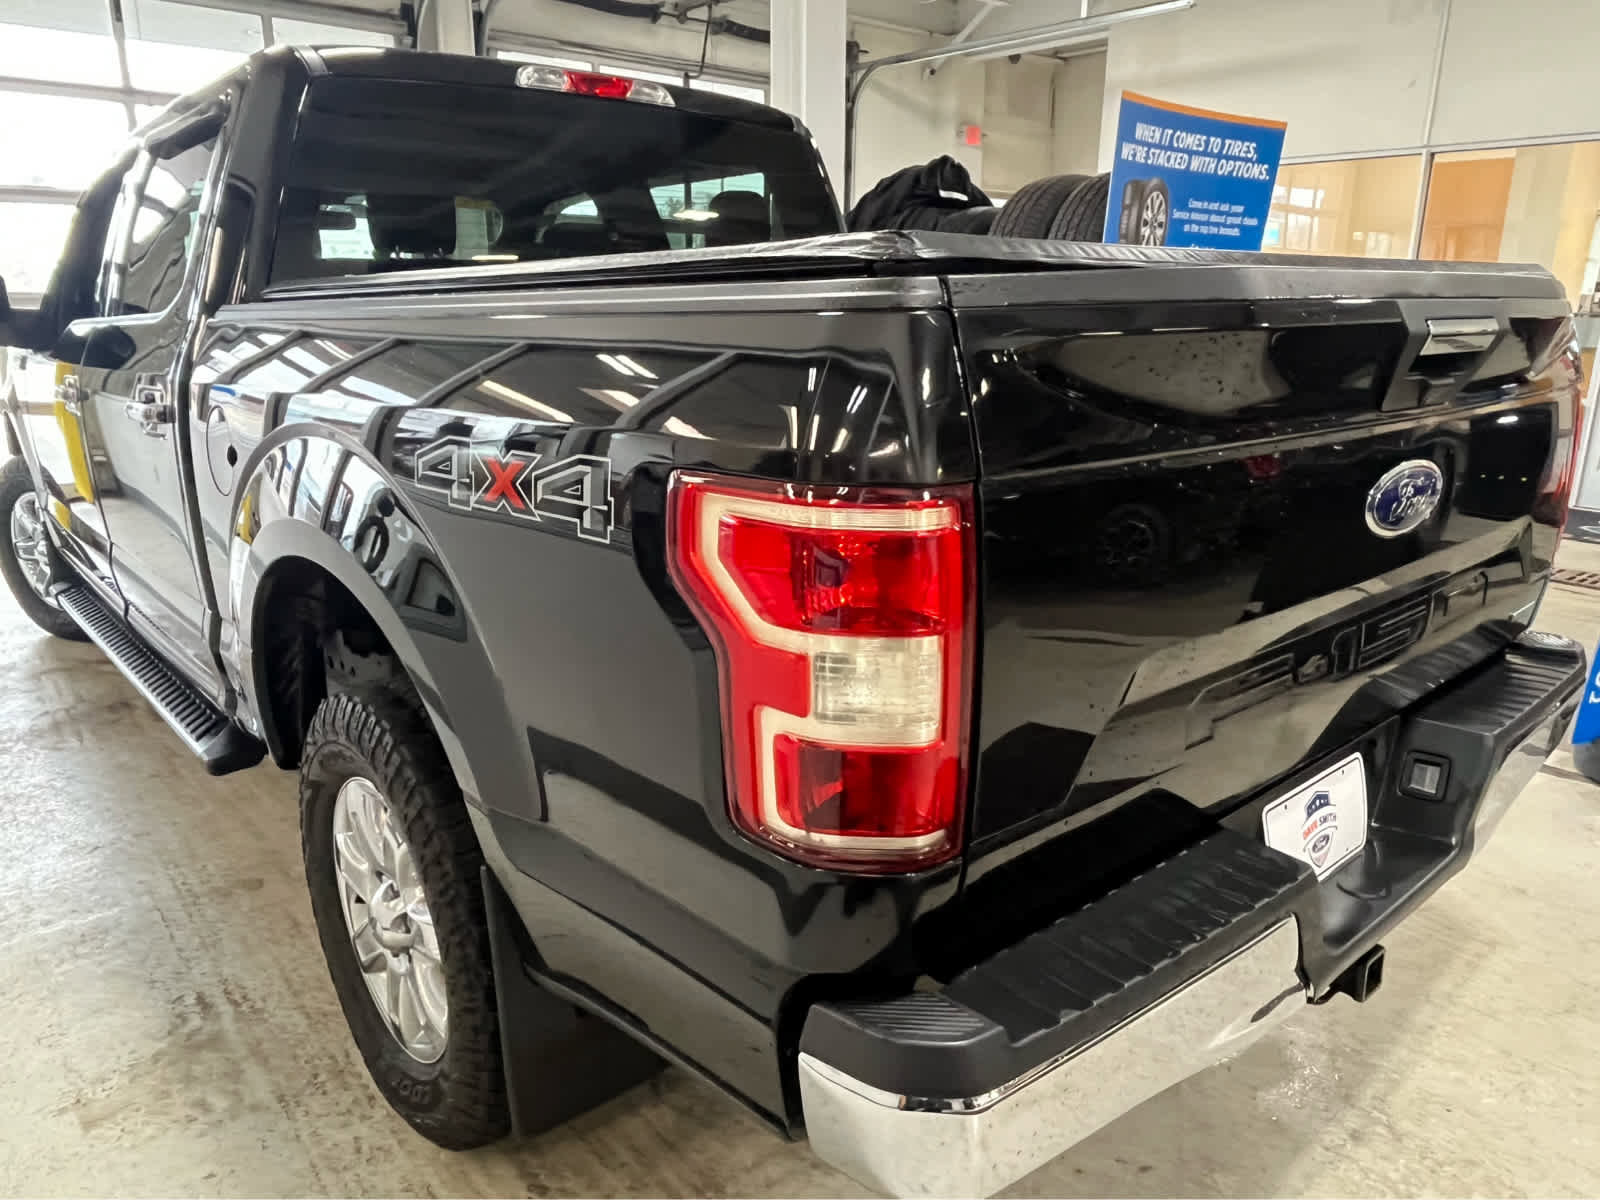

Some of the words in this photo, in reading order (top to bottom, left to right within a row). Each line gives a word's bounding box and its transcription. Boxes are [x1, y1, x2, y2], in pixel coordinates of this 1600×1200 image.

[1136, 122, 1163, 144] WHEN
[1162, 128, 1173, 146] IT
[1173, 130, 1207, 152] COMES
[1208, 135, 1222, 153] TO
[1223, 138, 1257, 161] TIRES,
[1147, 147, 1189, 169] STACKED
[1190, 154, 1218, 174] WITH
[1217, 158, 1269, 180] OPTIONS.
